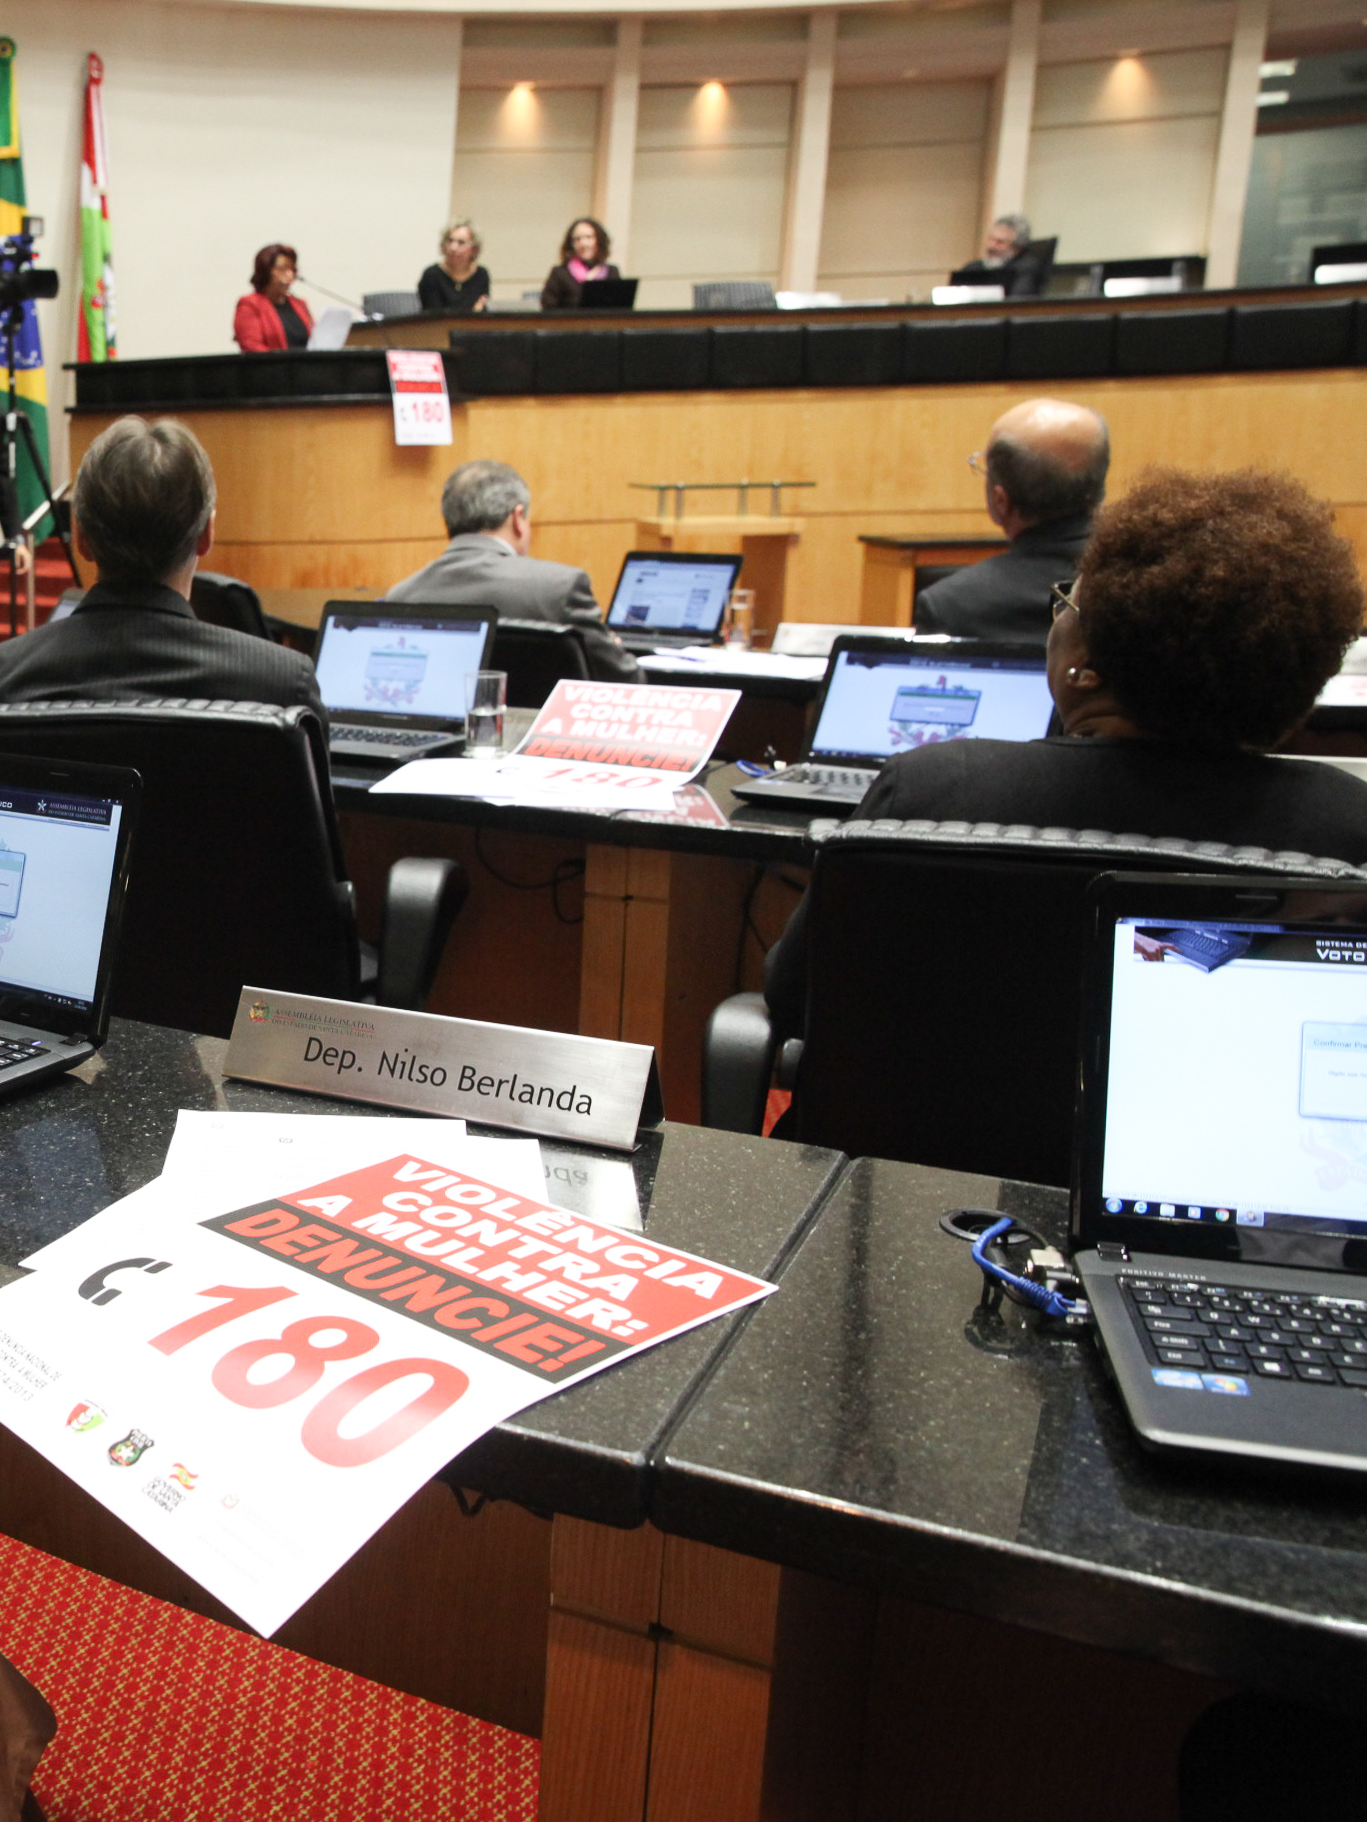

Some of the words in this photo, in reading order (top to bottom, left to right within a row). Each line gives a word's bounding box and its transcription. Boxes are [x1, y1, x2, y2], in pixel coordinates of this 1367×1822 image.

[412, 401, 445, 423] 180
[564, 685, 722, 712] VIOLÊNCIA
[570, 703, 694, 728] CONTRA
[540, 718, 564, 734] A
[569, 720, 708, 747] MULHER:
[523, 737, 700, 771] DENUNCIE!
[543, 768, 664, 788] 180
[1315, 939, 1353, 948] SISTEMA
[1316, 948, 1365, 962] VOTO
[303, 1036, 363, 1075] Dep.
[377, 1048, 447, 1087] Nilso
[457, 1065, 593, 1116] Berlanda
[392, 1161, 724, 1299] VIOLÊNCIA
[382, 1192, 639, 1301] CONTRA
[297, 1195, 353, 1217] A
[351, 1216, 648, 1337] MULHER:
[223, 1208, 606, 1372] DENUNCIE!
[147, 1284, 470, 1468] 180
